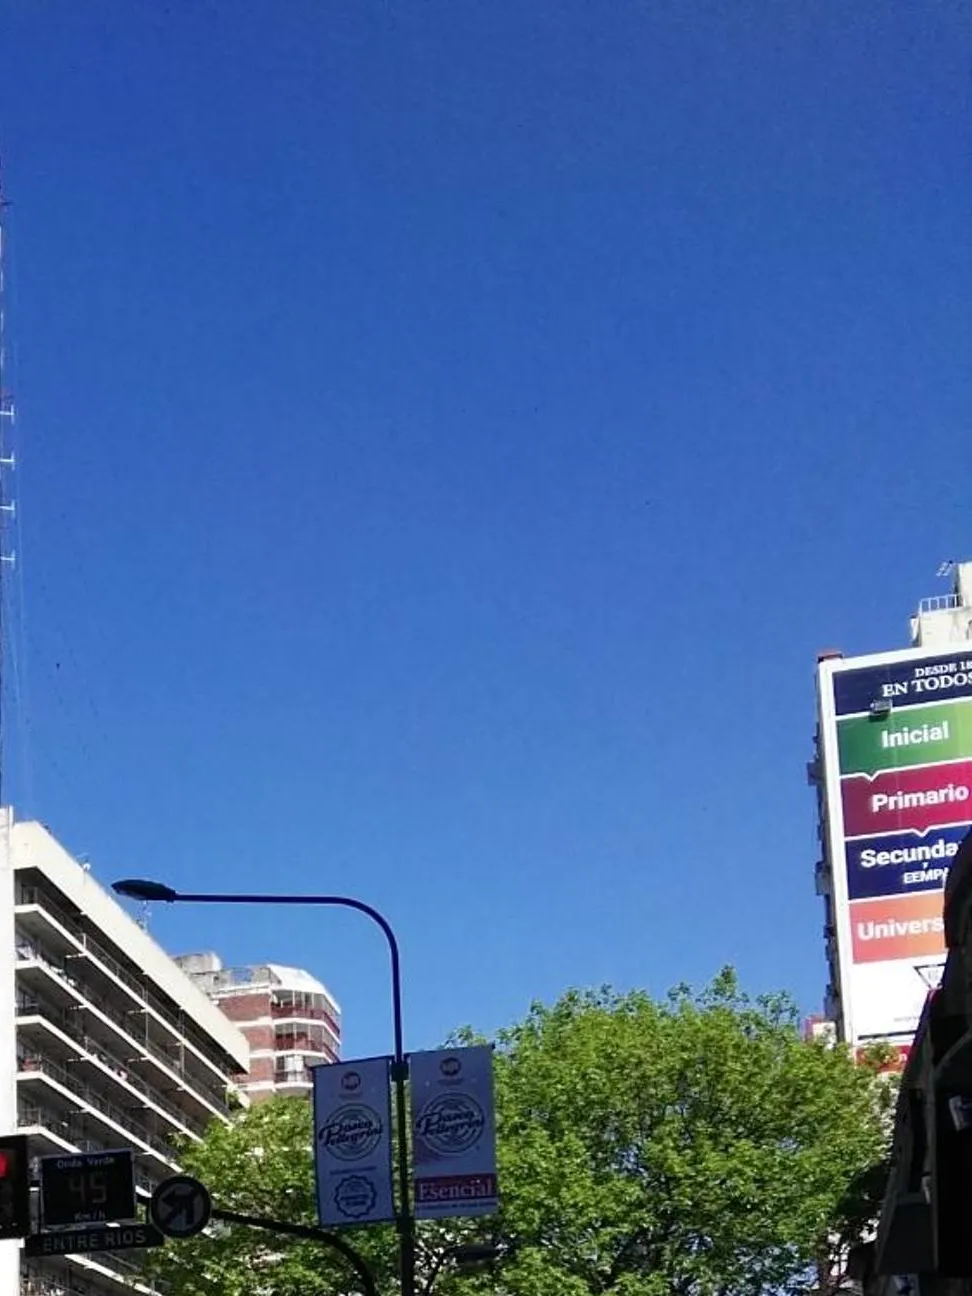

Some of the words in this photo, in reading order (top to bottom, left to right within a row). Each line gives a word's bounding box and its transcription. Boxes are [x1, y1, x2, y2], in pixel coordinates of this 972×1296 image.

[915, 662, 958, 678] DESDE
[882, 682, 908, 697] EN
[881, 720, 949, 748] Inicial
[871, 783, 970, 813] Primario
[860, 839, 960, 868] Secunda
[43, 1232, 101, 1253] ENTRE
